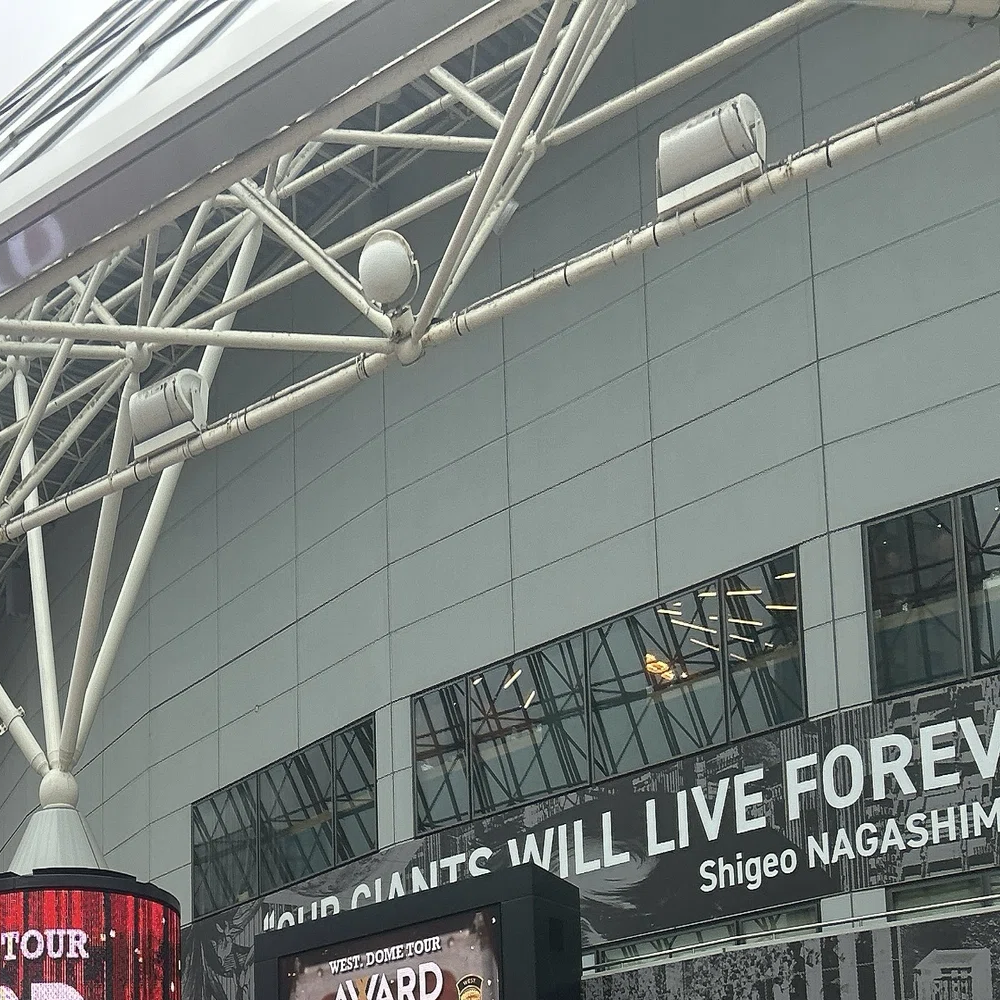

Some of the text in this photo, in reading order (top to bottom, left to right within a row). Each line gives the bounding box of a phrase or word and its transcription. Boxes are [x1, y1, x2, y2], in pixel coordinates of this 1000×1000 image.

[508, 811, 630, 878] WILL
[646, 768, 767, 857] LIVE
[785, 711, 1000, 821] FOREV
[700, 798, 1000, 892] Shigeo NAGASHIM
[1, 928, 89, 961] TOUR
[329, 936, 441, 974] WEST. DOME TOUR
